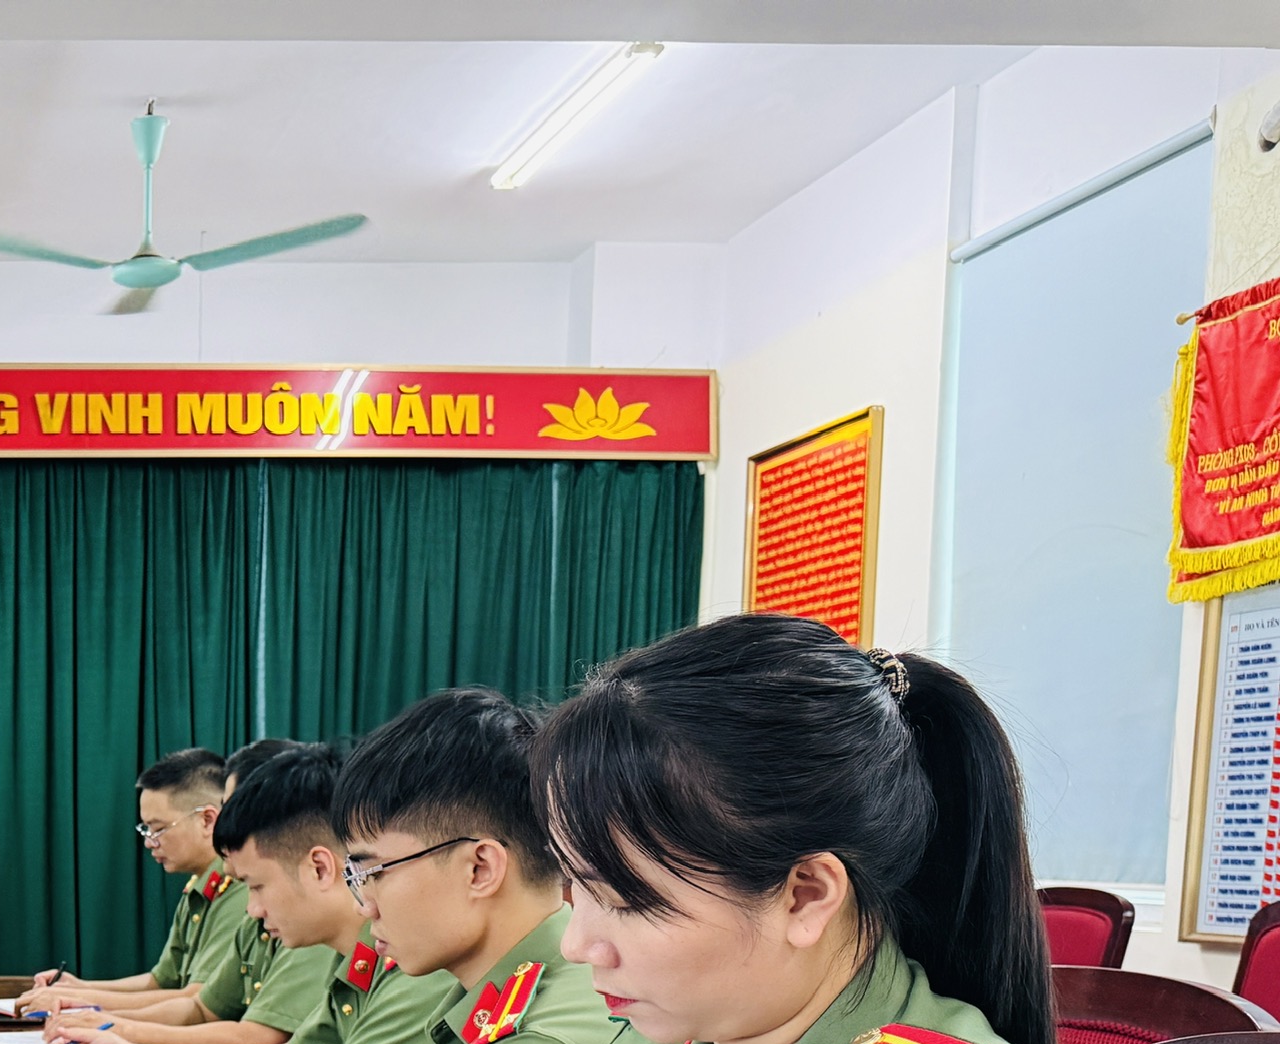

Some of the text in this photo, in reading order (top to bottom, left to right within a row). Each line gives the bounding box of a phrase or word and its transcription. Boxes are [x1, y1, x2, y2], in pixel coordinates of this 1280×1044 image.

[34, 393, 162, 435] VINH
[177, 382, 340, 436] MUÔN
[352, 384, 494, 436] NĂM!
